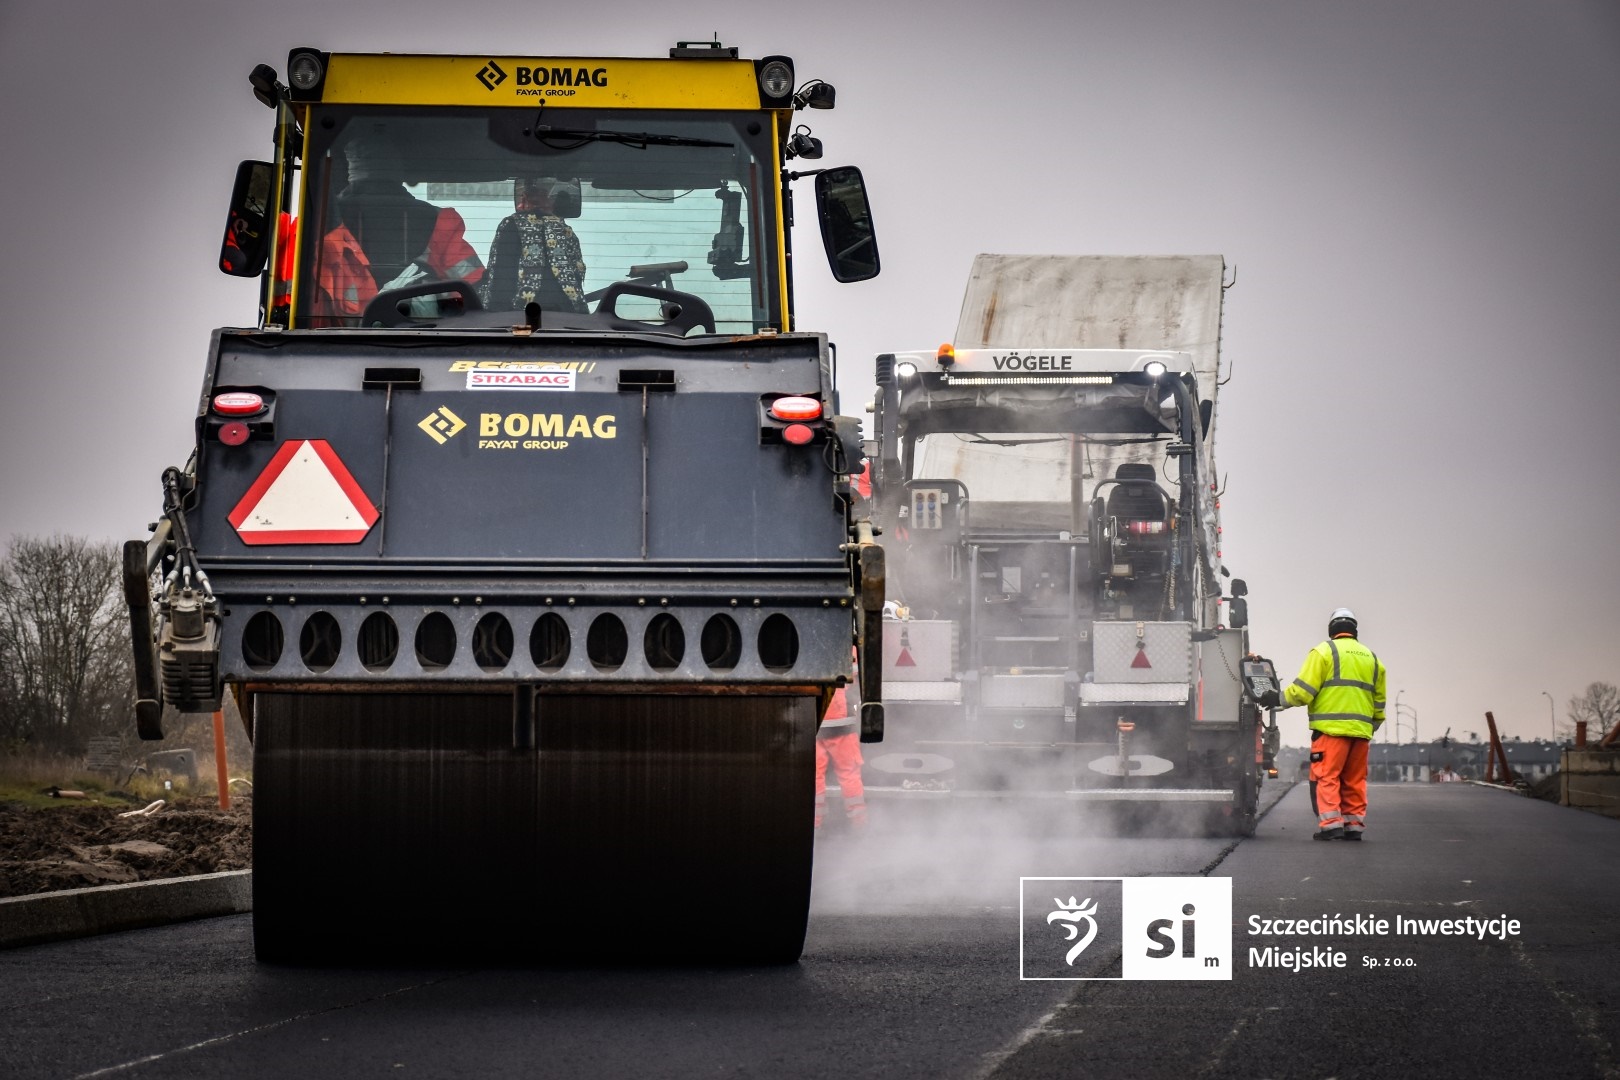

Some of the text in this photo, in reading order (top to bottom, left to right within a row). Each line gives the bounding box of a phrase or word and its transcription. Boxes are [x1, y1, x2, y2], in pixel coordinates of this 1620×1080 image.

[516, 66, 608, 87] BOMAG
[516, 88, 576, 97] FAYAT GROUP
[992, 352, 1072, 370] VÖGELE
[472, 374, 570, 385] STRABAG
[479, 412, 617, 439] BOMAG
[478, 440, 569, 450] FAYAT GROUP
